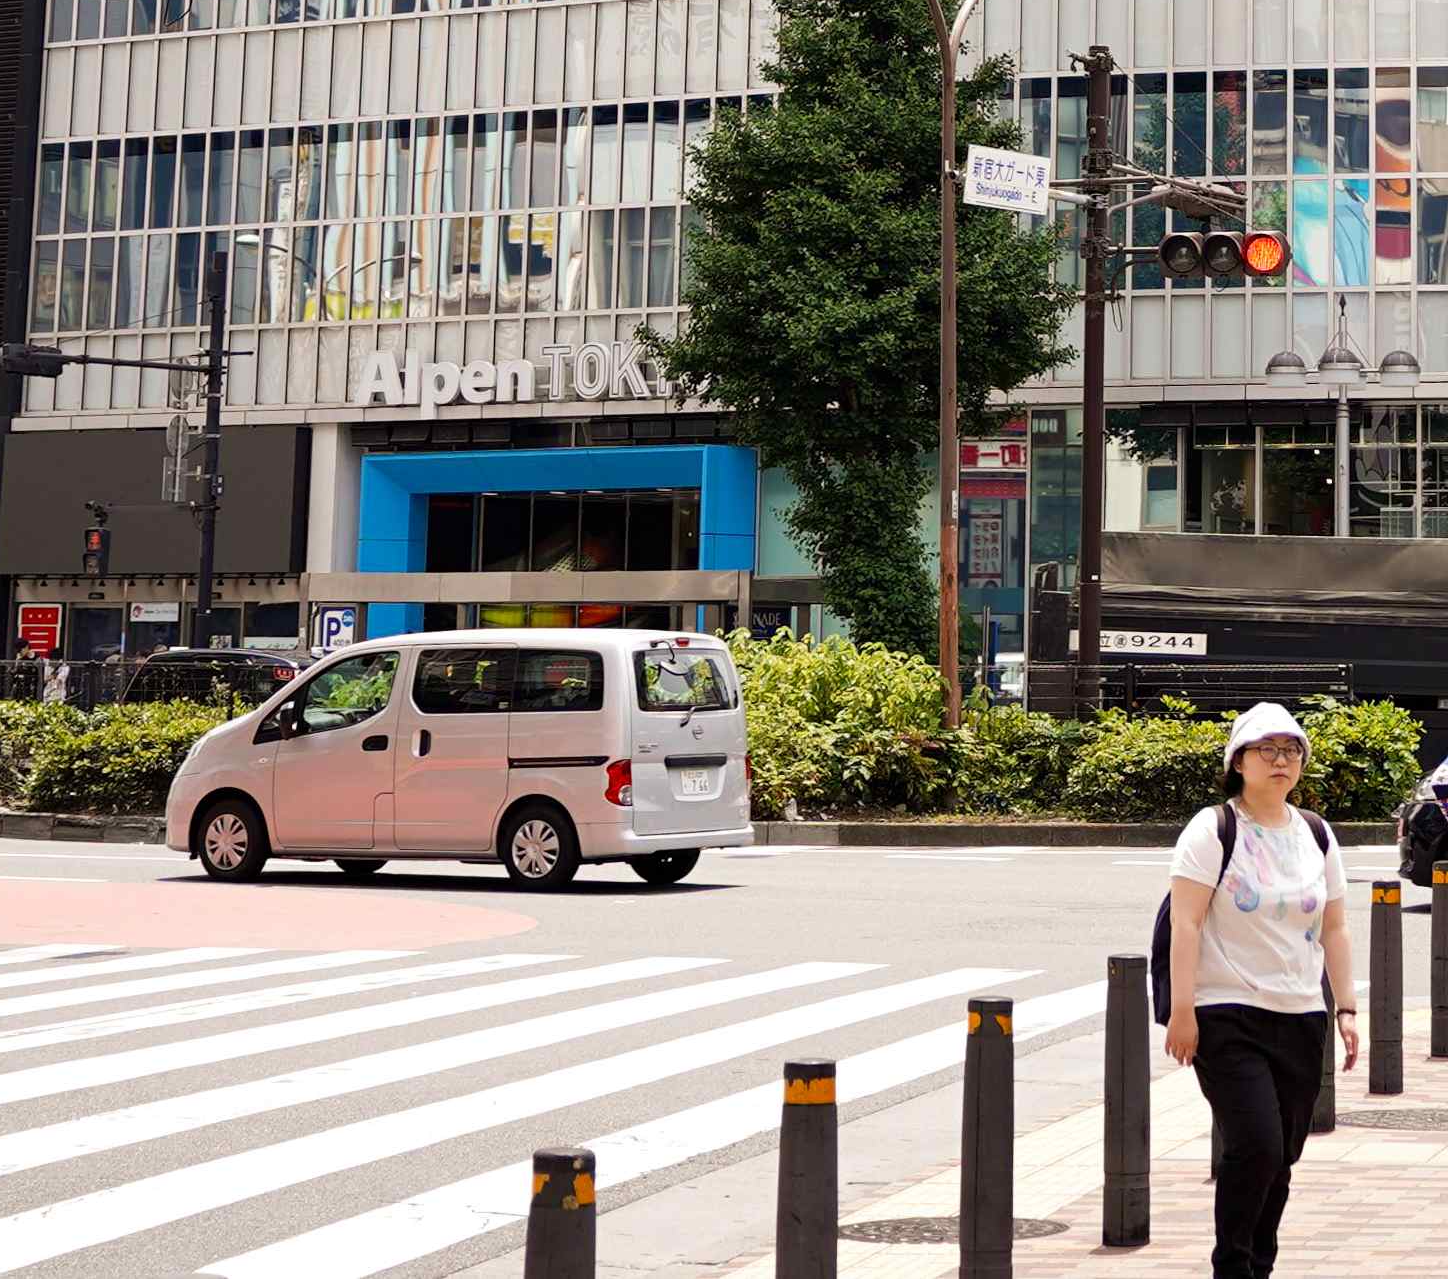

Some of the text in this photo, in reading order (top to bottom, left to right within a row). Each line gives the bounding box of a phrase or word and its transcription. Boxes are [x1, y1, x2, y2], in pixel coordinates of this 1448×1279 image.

[974, 156, 1046, 189] 新宿大ガード東
[357, 342, 692, 420] Alpen TOK
[327, 617, 341, 647] P
[1131, 635, 1195, 649] 9244
